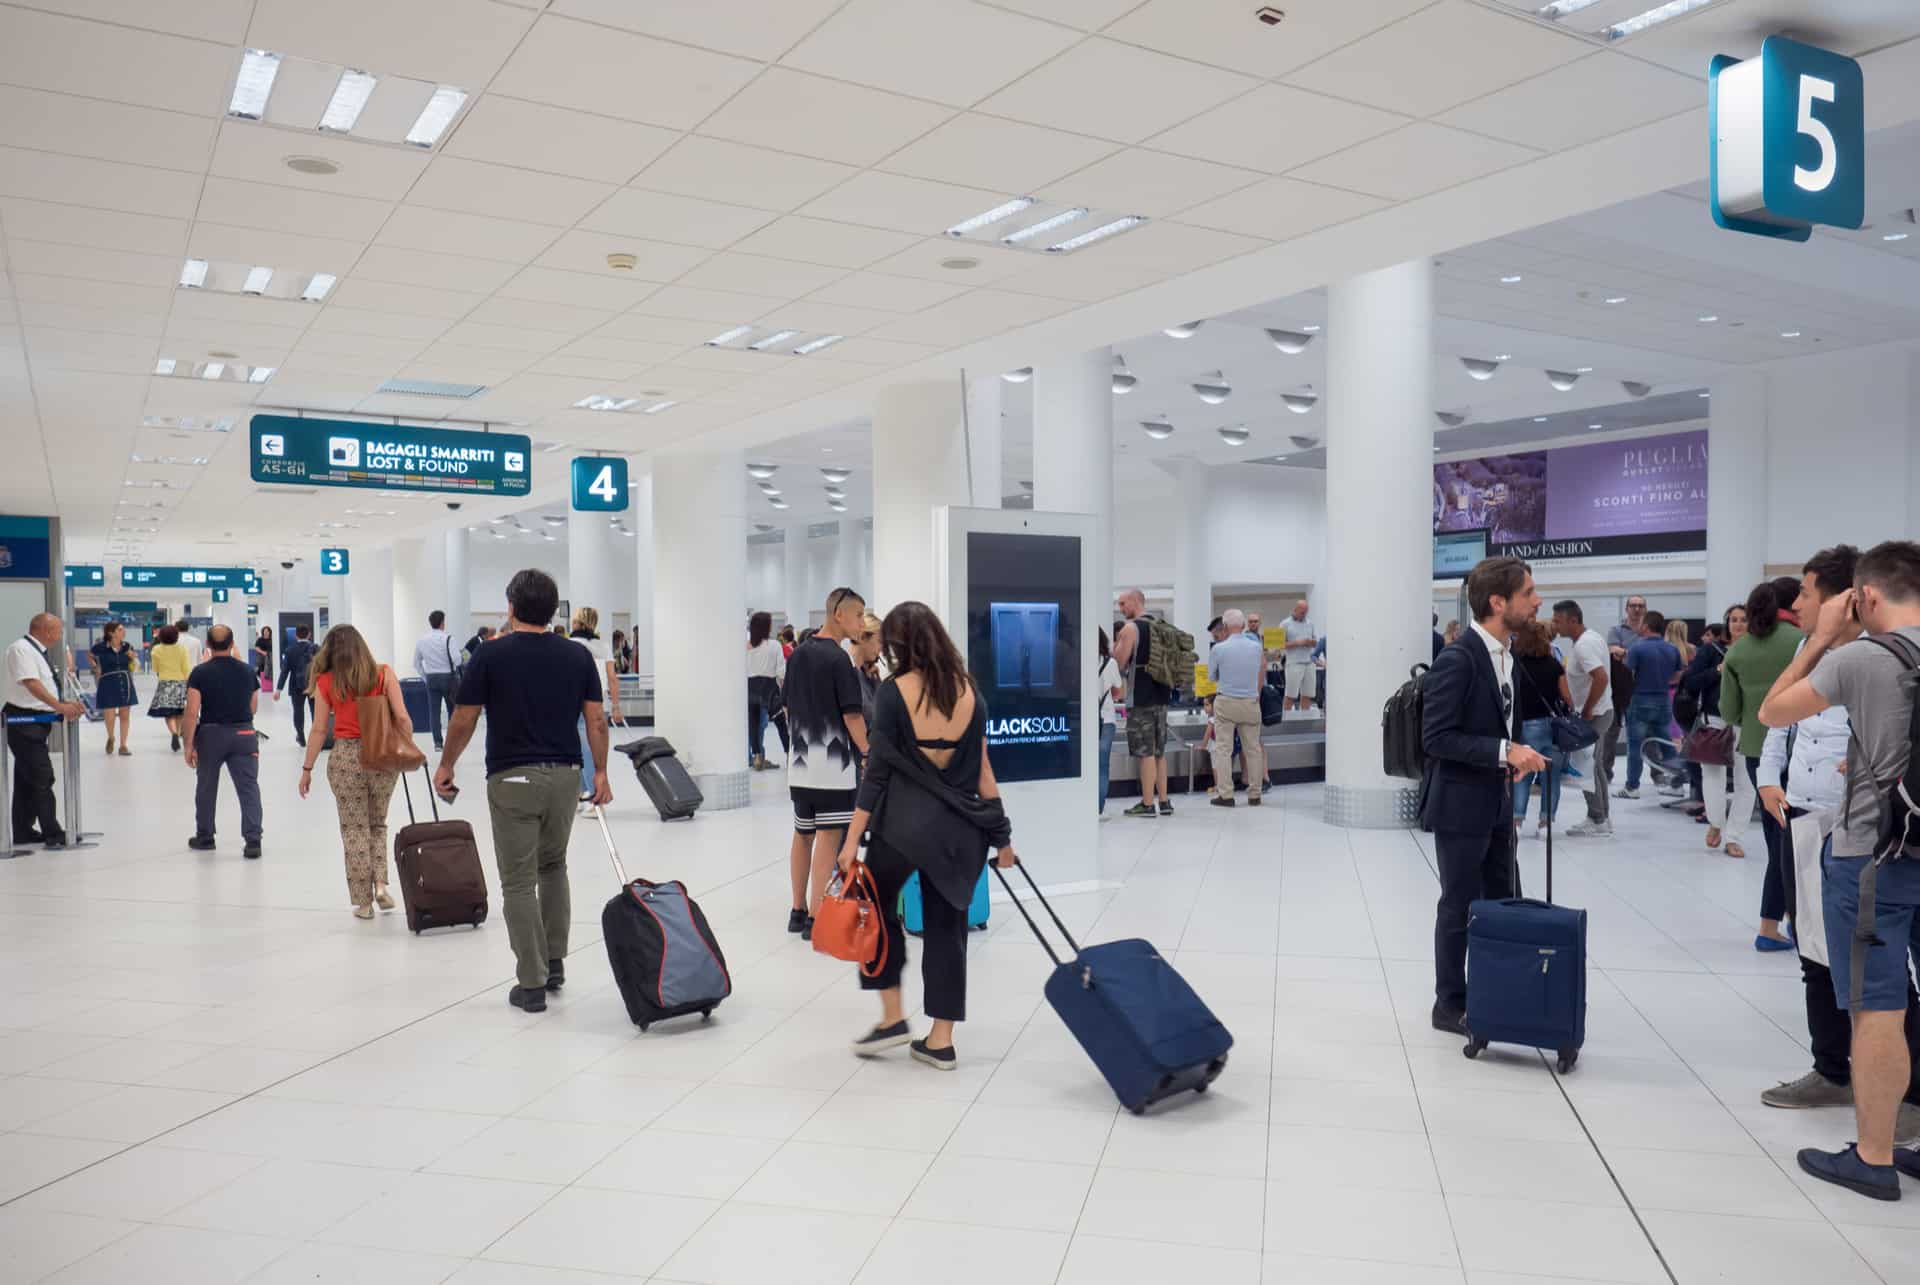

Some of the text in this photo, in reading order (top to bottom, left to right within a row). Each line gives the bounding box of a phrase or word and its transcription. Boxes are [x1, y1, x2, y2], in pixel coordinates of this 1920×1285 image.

[1794, 73, 1836, 192] 5
[366, 441, 495, 463] BAGAGLI SMARRITI
[366, 455, 468, 474] LOST & FOUND
[588, 465, 617, 502] 4
[1593, 495, 1643, 508] SCONTI
[1649, 490, 1683, 503] FINO
[1502, 543, 1531, 558] LAND
[1541, 540, 1593, 555] FASHION
[328, 551, 342, 571] 3
[216, 590, 224, 601] 1
